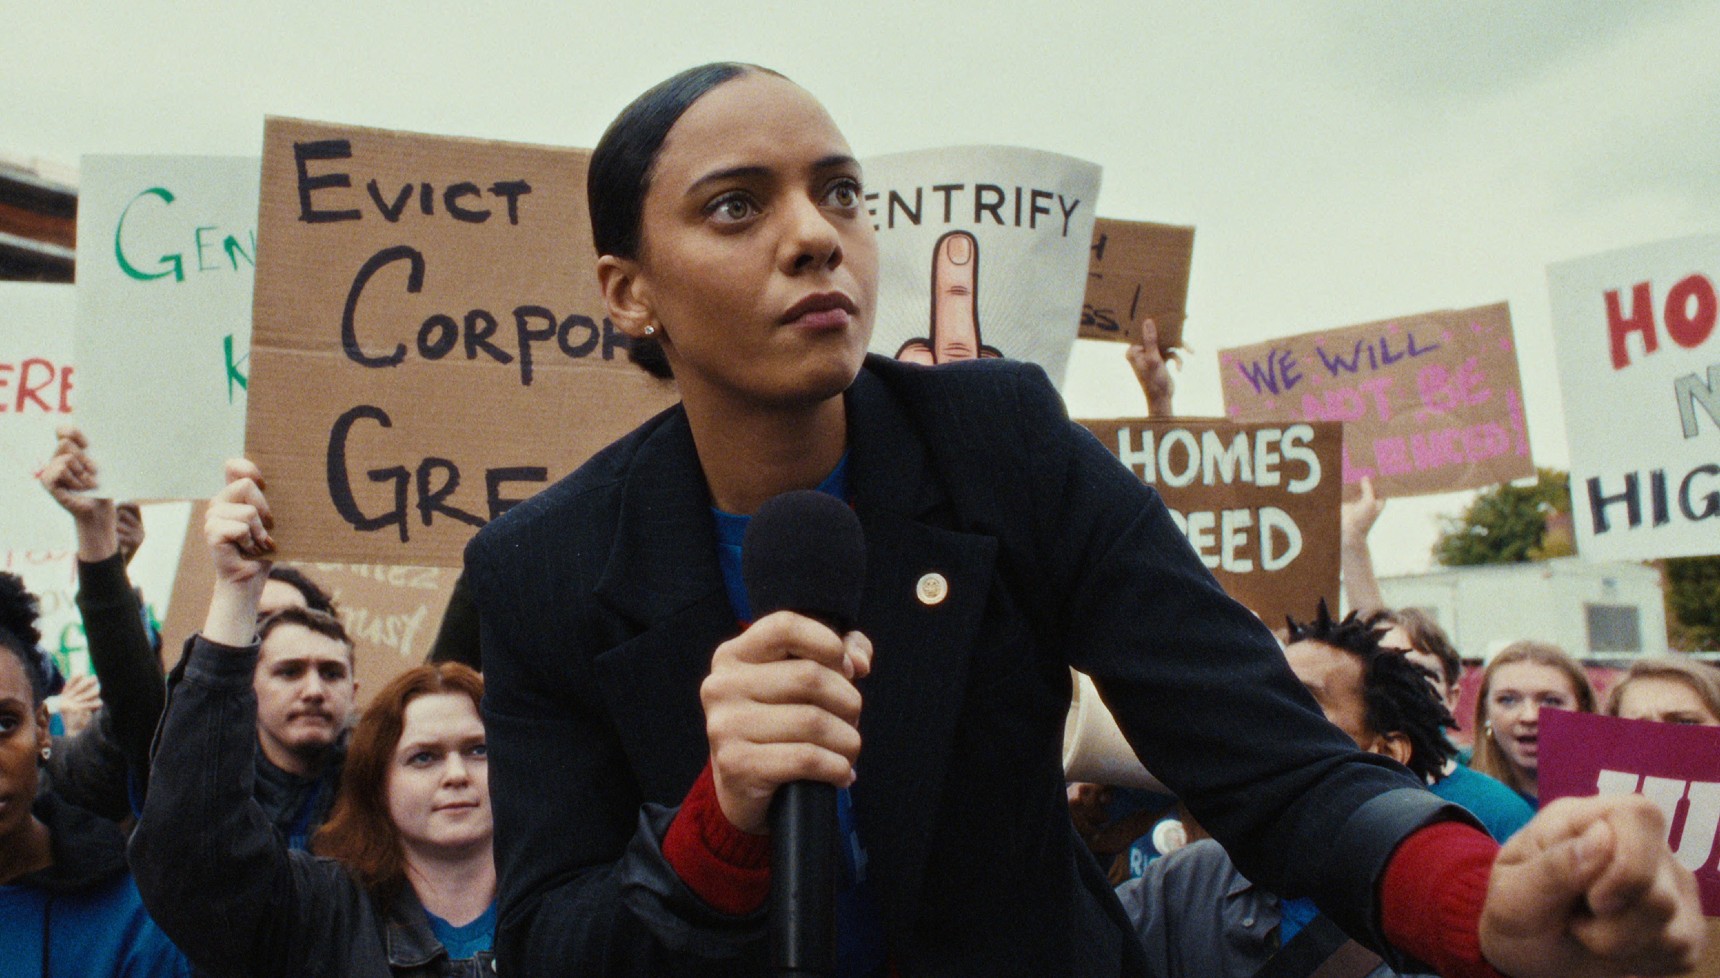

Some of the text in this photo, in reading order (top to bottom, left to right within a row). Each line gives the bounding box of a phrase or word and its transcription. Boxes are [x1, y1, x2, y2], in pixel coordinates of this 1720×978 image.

[294, 139, 532, 225] EVICT
[1238, 332, 1440, 395] WE WILL
[1416, 356, 1493, 413] BE
[1117, 424, 1322, 494] HOMES
[1168, 506, 1303, 573] EED
